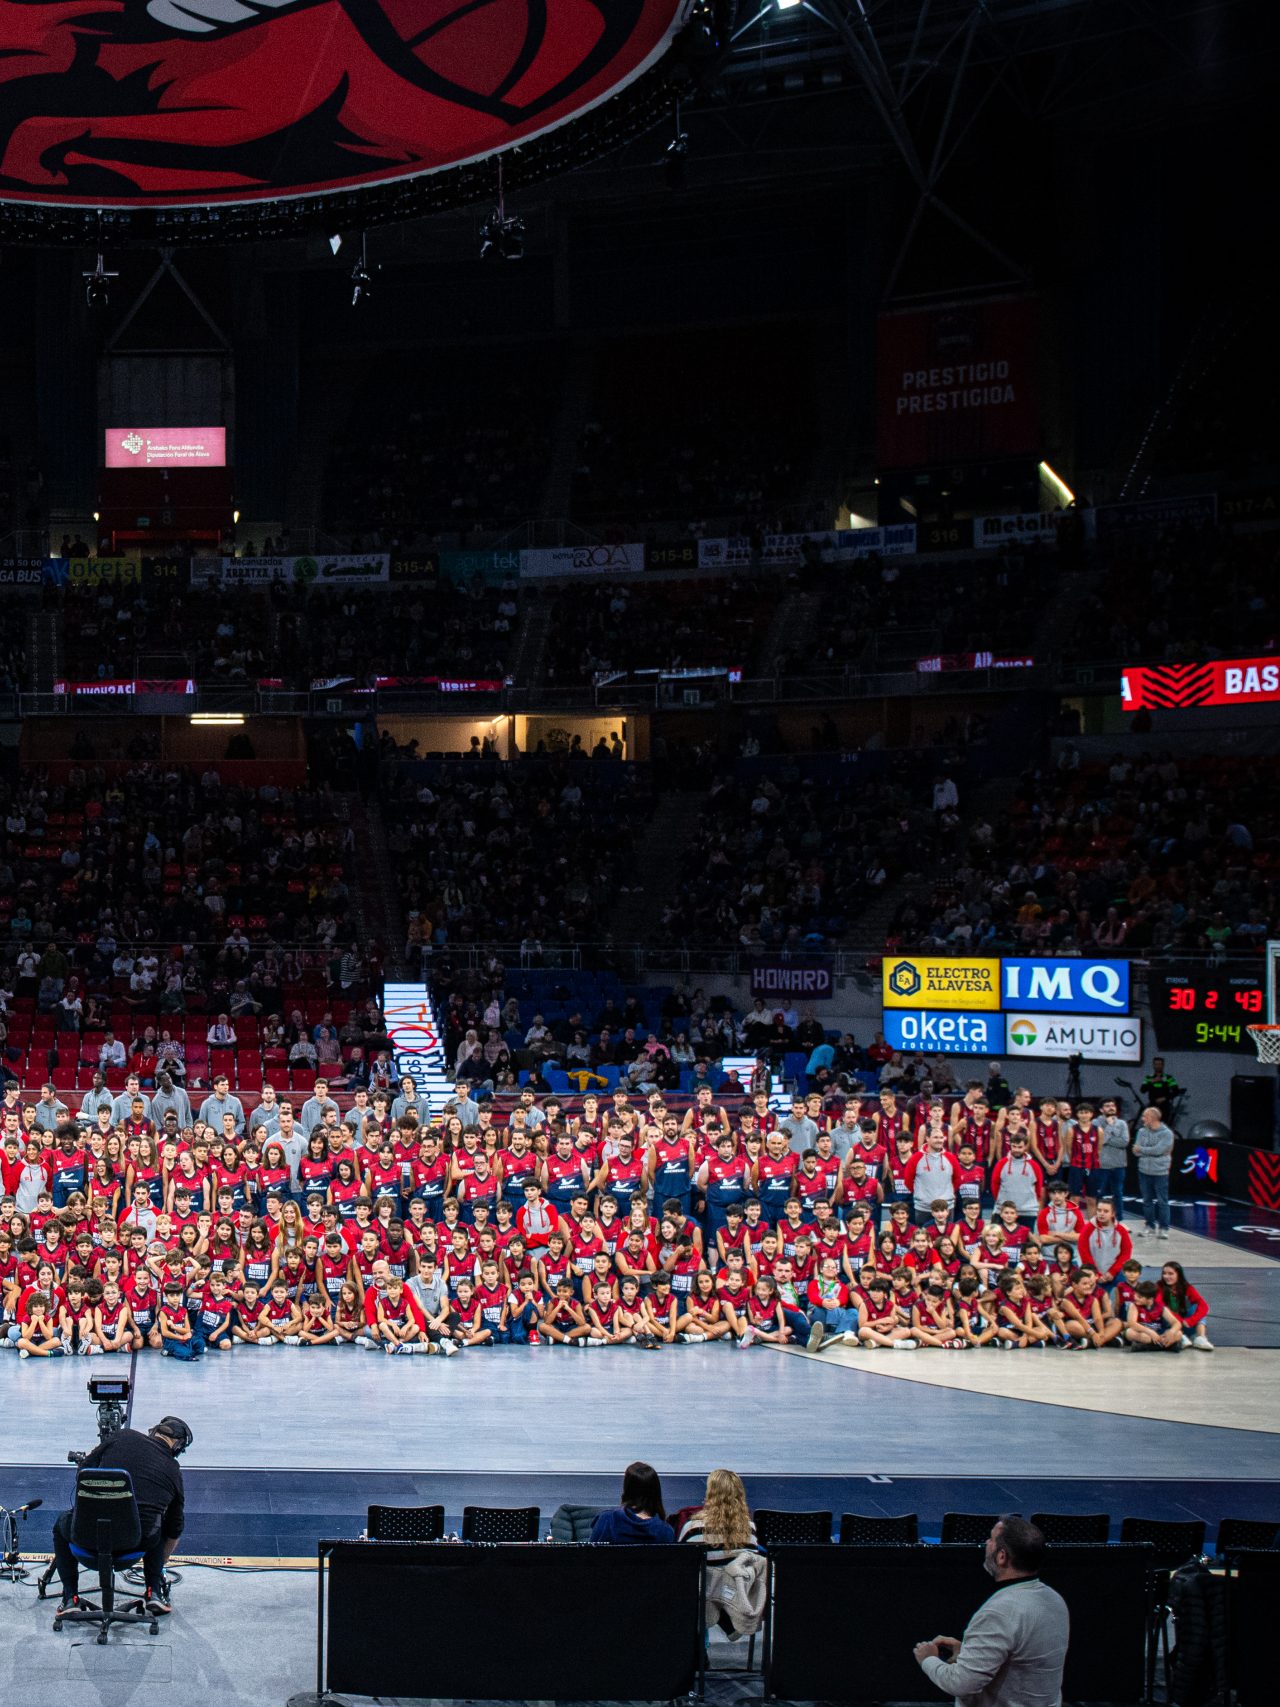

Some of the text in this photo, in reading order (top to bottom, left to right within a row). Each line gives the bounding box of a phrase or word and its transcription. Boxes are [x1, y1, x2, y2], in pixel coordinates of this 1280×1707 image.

[902, 360, 1010, 391] PRESTIGIO
[896, 384, 1016, 416] PRESTIGIOA
[1224, 497, 1275, 514] 317-A
[930, 529, 959, 543] 316
[651, 548, 693, 562] 315-B
[17, 569, 41, 583] BUS
[72, 557, 137, 578] oketa
[153, 564, 177, 578] 314
[396, 562, 434, 574] 315-A
[753, 967, 829, 991] HOWARD
[926, 967, 991, 979] ELECTRO
[926, 980, 993, 992] ALAVESA
[1006, 965, 1125, 1007] IMQ
[1169, 987, 1263, 1012] 30 2 43
[901, 1011, 987, 1043] oketa
[1196, 1023, 1241, 1043] 9:44
[1045, 1027, 1137, 1047] AMUTIO
[901, 1042, 988, 1052] rotulación
